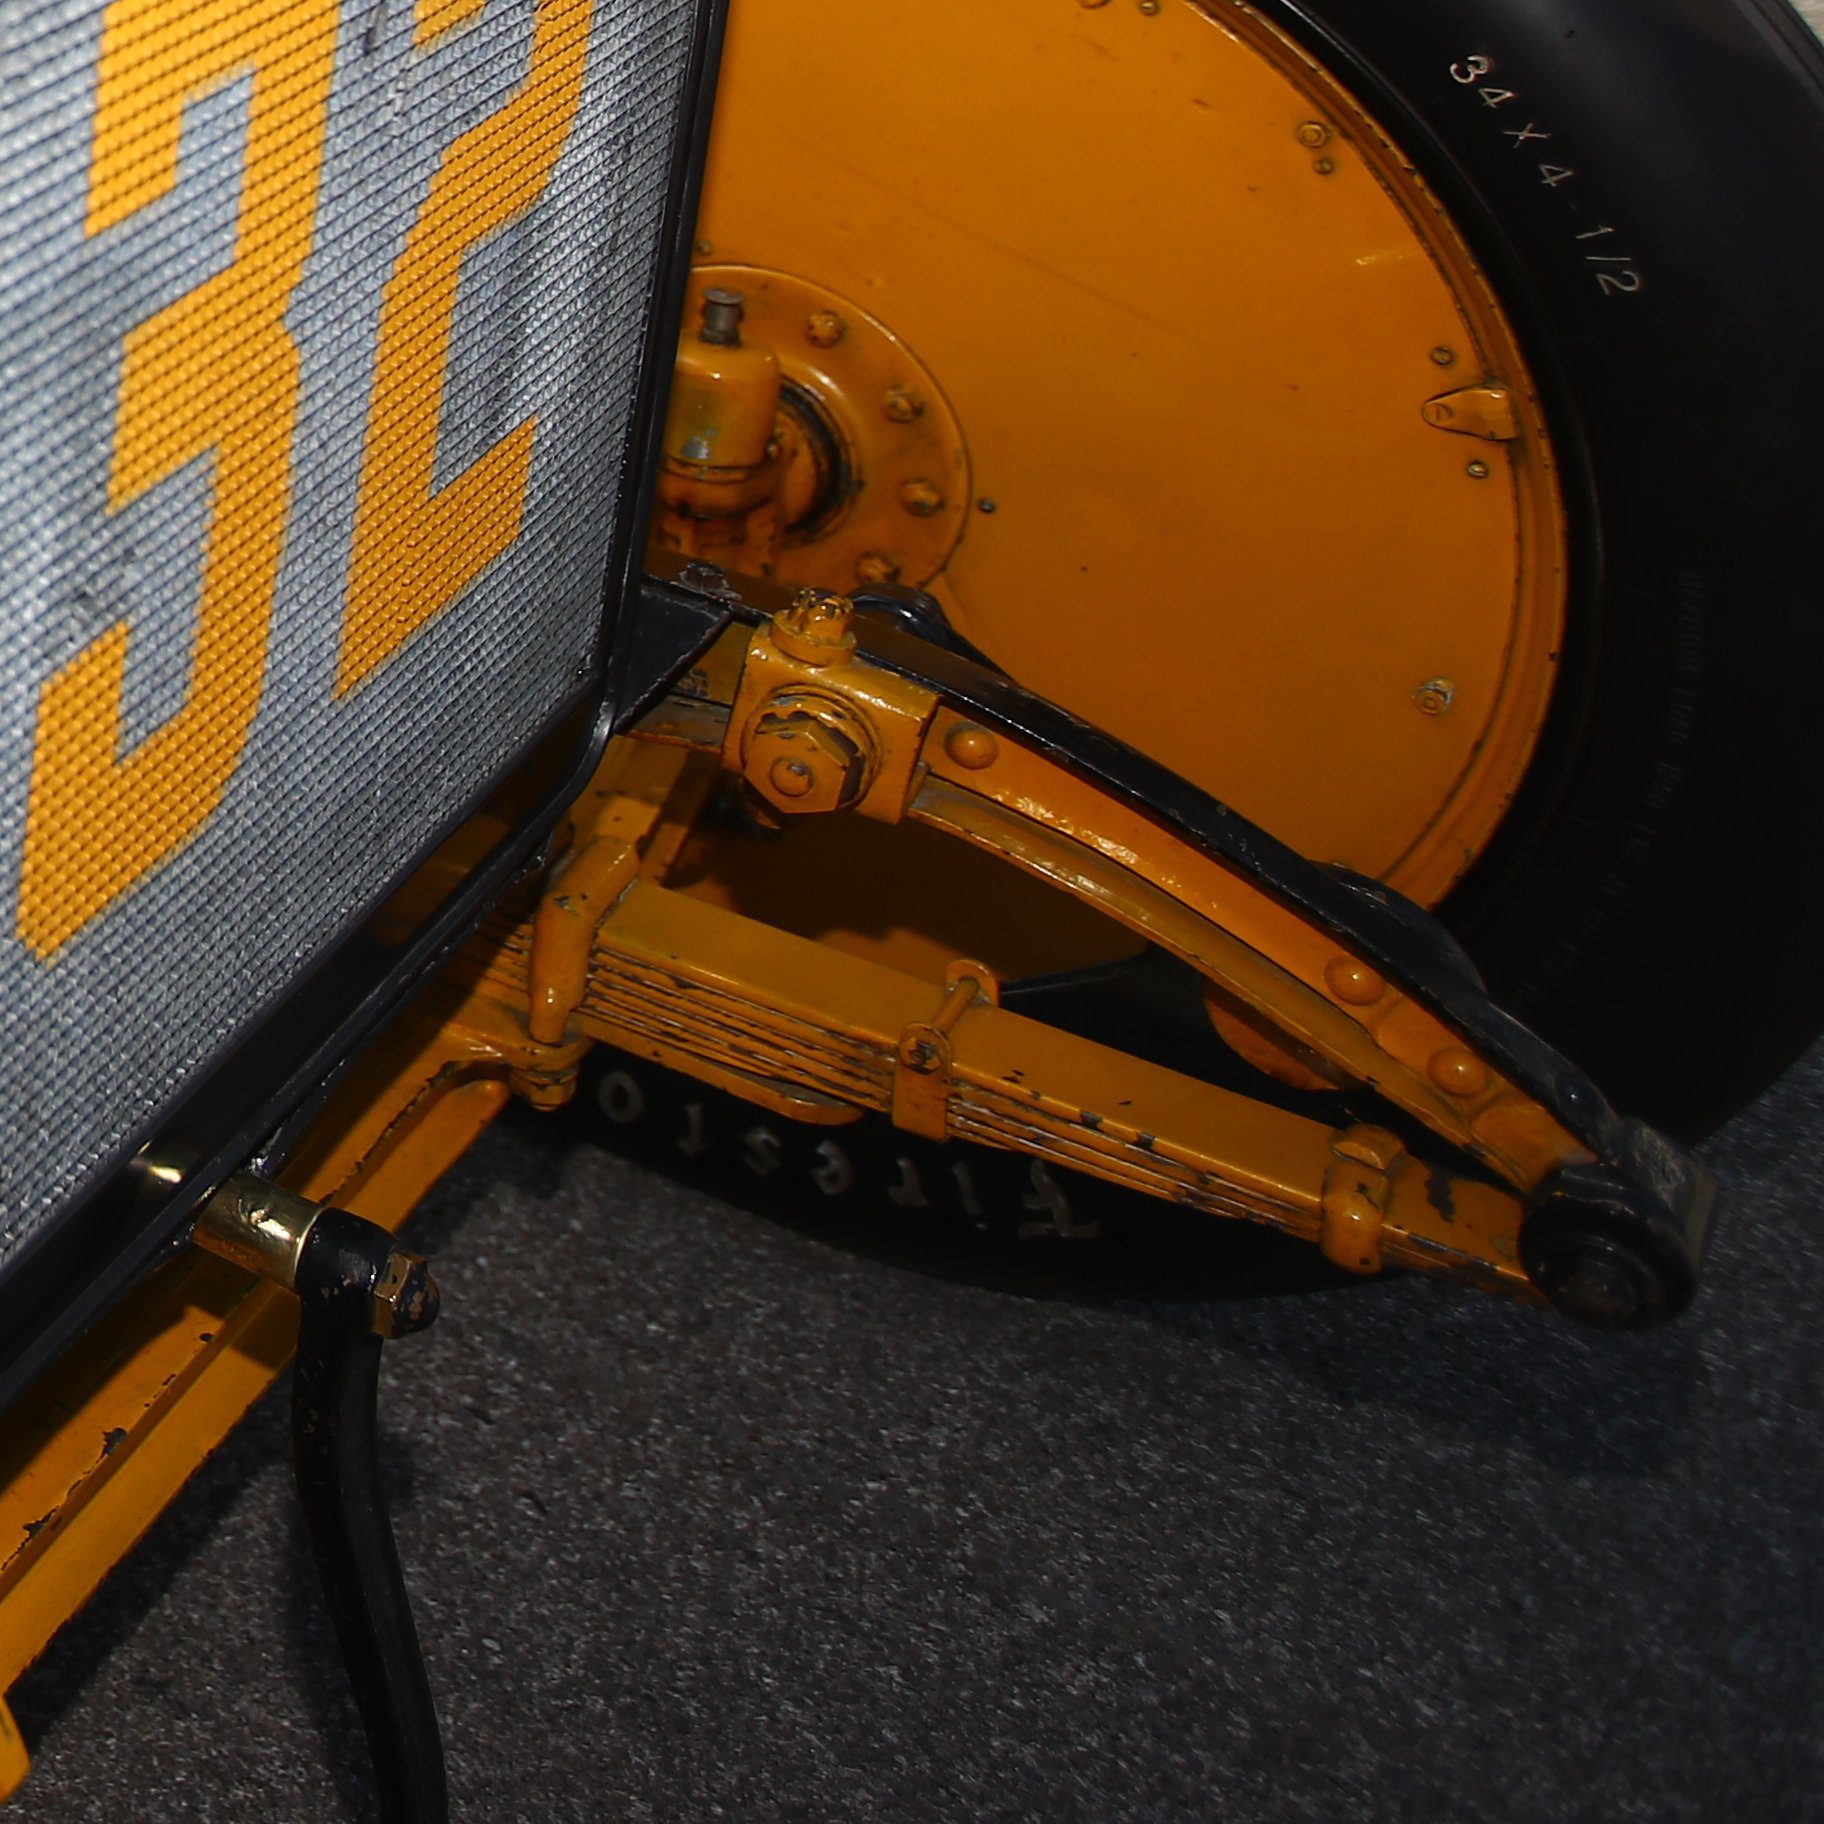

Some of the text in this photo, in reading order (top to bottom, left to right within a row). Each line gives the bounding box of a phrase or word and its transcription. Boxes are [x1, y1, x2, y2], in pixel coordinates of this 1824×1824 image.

[1449, 54, 1516, 109] 34
[1539, 164, 1574, 187] 4
[1575, 224, 1640, 296] 1/2
[595, 1069, 1101, 1242] Firesto
